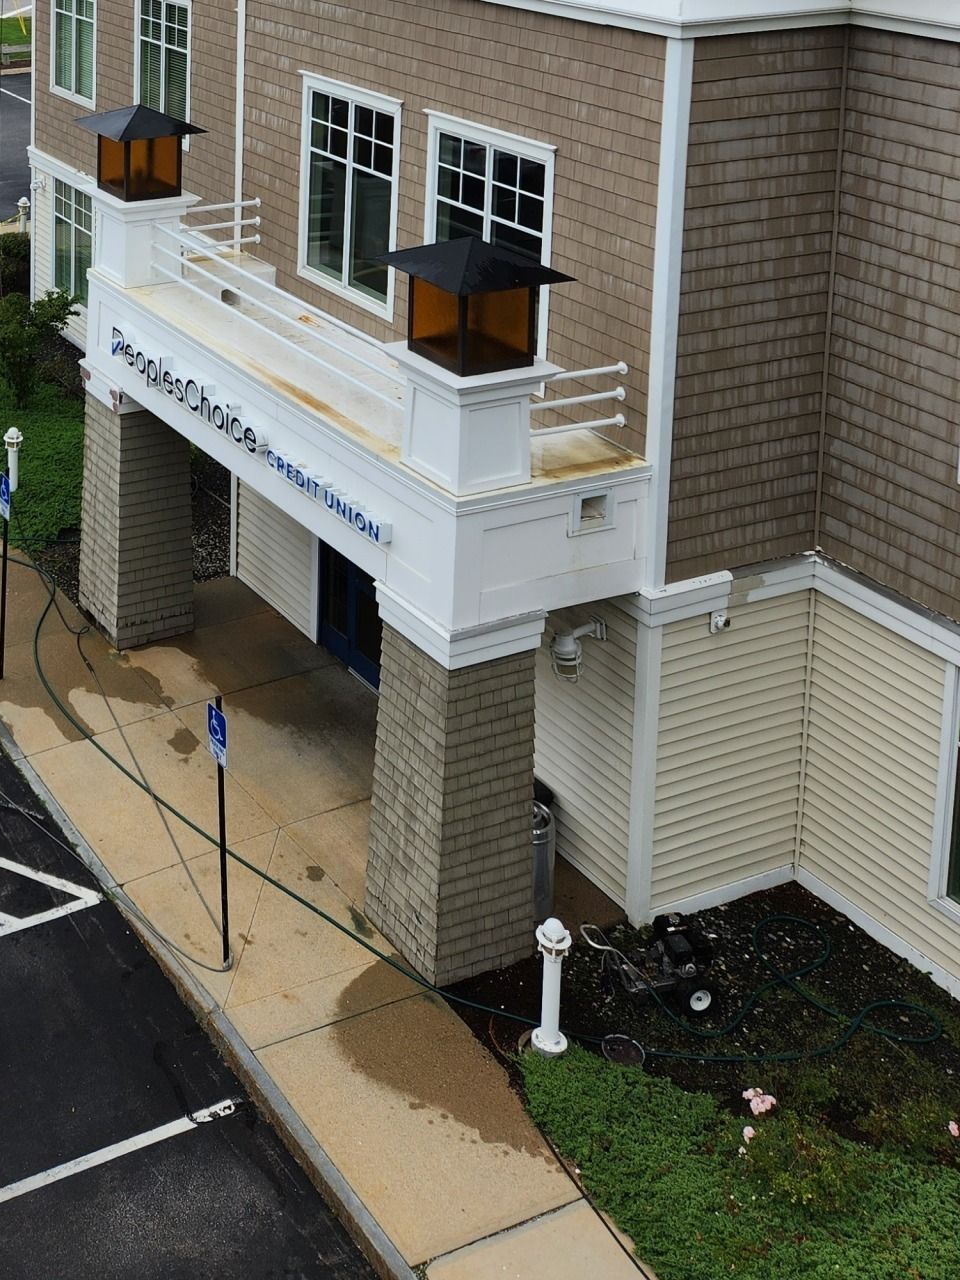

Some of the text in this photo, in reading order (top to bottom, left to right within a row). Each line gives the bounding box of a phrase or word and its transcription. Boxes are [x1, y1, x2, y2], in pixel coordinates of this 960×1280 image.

[112, 326, 381, 543] PeoplesChoice CREDIT UNION
